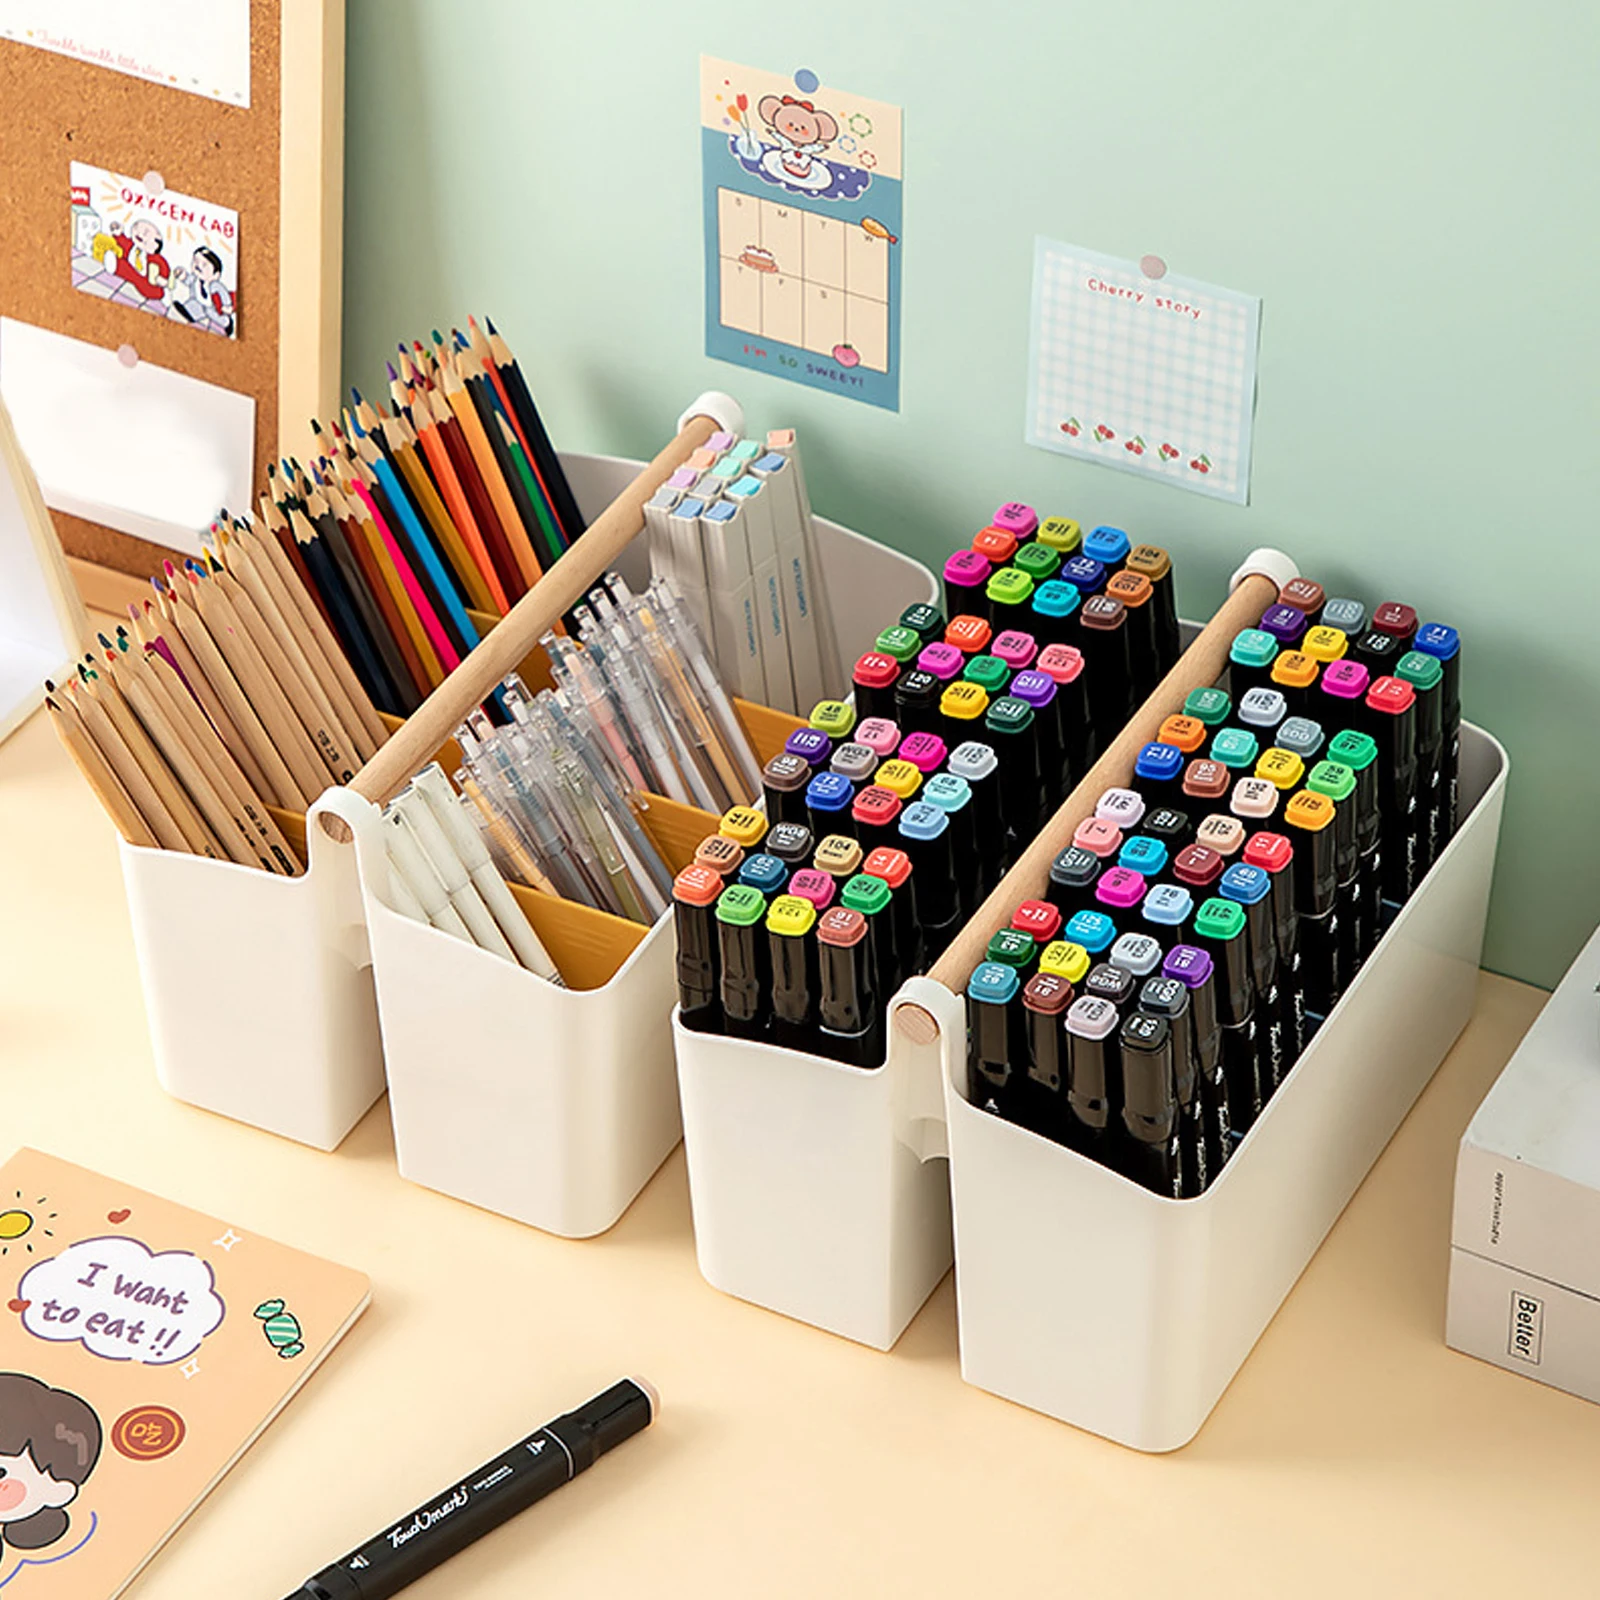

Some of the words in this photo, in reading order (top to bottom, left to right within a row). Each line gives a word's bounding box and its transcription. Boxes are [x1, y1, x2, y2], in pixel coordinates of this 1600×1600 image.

[121, 187, 195, 223] OXYGEN
[199, 215, 235, 239] LAB
[1087, 278, 1144, 303] Cherry
[1155, 297, 1201, 320] story
[1140, 548, 1159, 558] 104
[1174, 719, 1191, 727] 23
[1267, 760, 1284, 769] 37
[1246, 781, 1267, 791] 132
[861, 796, 881, 806] 121
[1217, 823, 1232, 834] 25
[829, 839, 850, 850] 104
[1138, 1019, 1157, 1036] 120
[77, 1262, 108, 1288] I
[113, 1273, 189, 1315] want
[42, 1298, 80, 1324] to
[85, 1311, 145, 1345] eat
